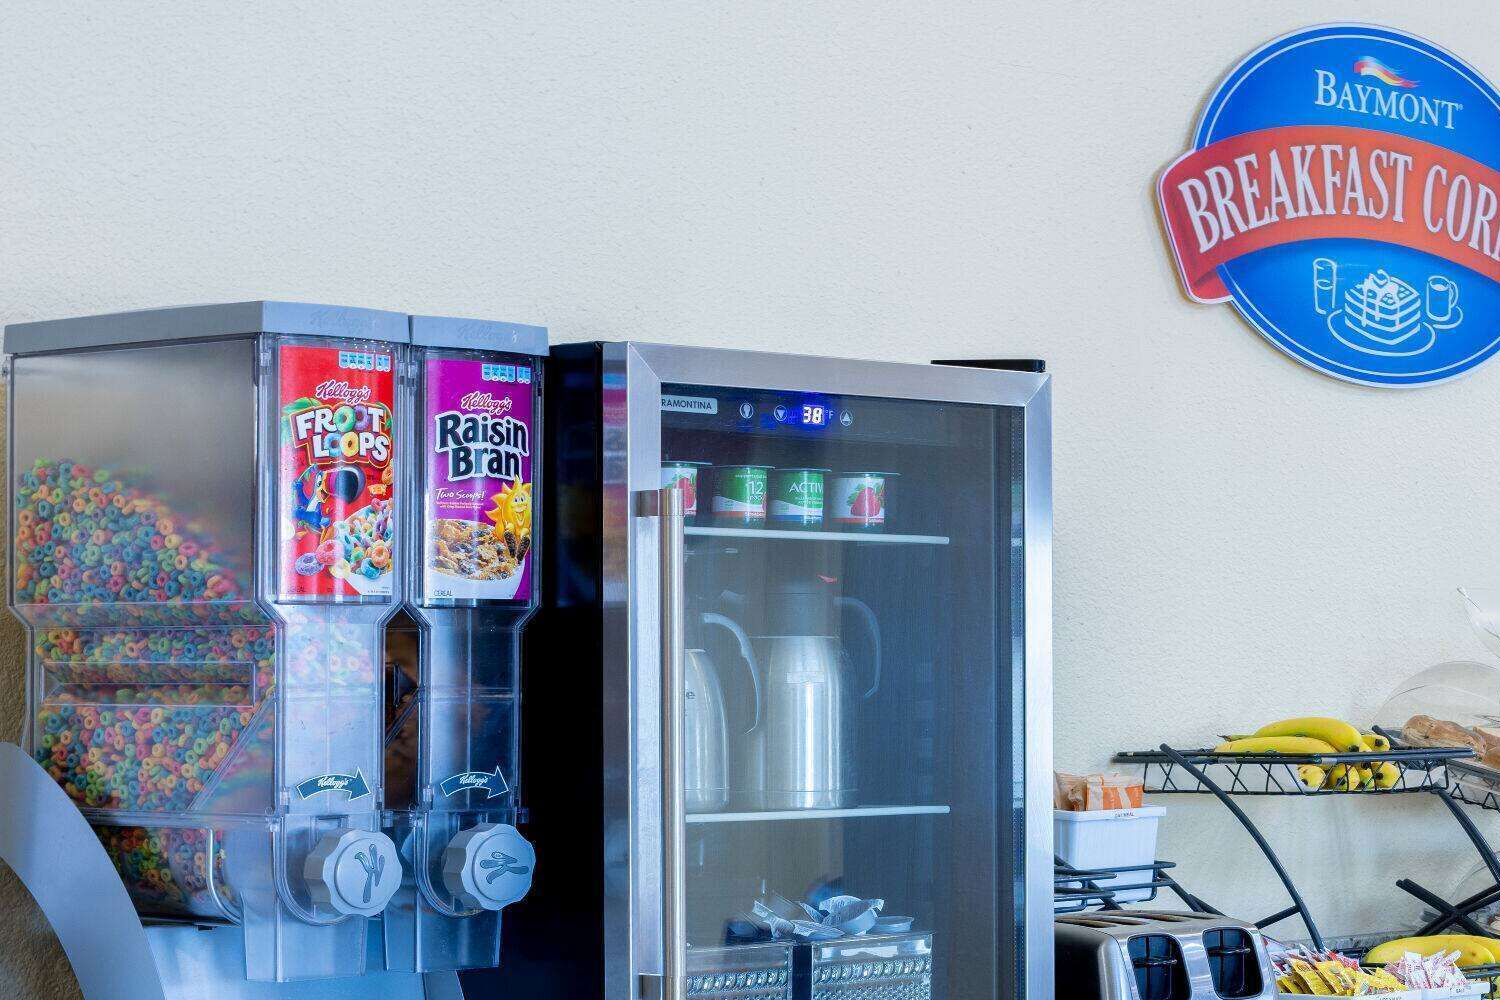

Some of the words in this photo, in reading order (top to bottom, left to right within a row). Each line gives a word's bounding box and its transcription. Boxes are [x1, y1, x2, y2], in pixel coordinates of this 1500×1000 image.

[1314, 68, 1459, 130] BAYMONT
[1178, 144, 1413, 254] BREAKFAST
[316, 379, 372, 405] Kellogg's
[461, 391, 512, 415] Kellogg's
[295, 405, 385, 440] FROOT
[803, 405, 824, 424] 38
[312, 431, 390, 462] LOOPS
[438, 413, 528, 455] Raisin
[451, 445, 520, 479] Bran
[435, 487, 454, 500] Two
[456, 489, 486, 501] Scoops!
[317, 776, 350, 790] Kellogg's
[458, 774, 490, 787] Kellogg's
